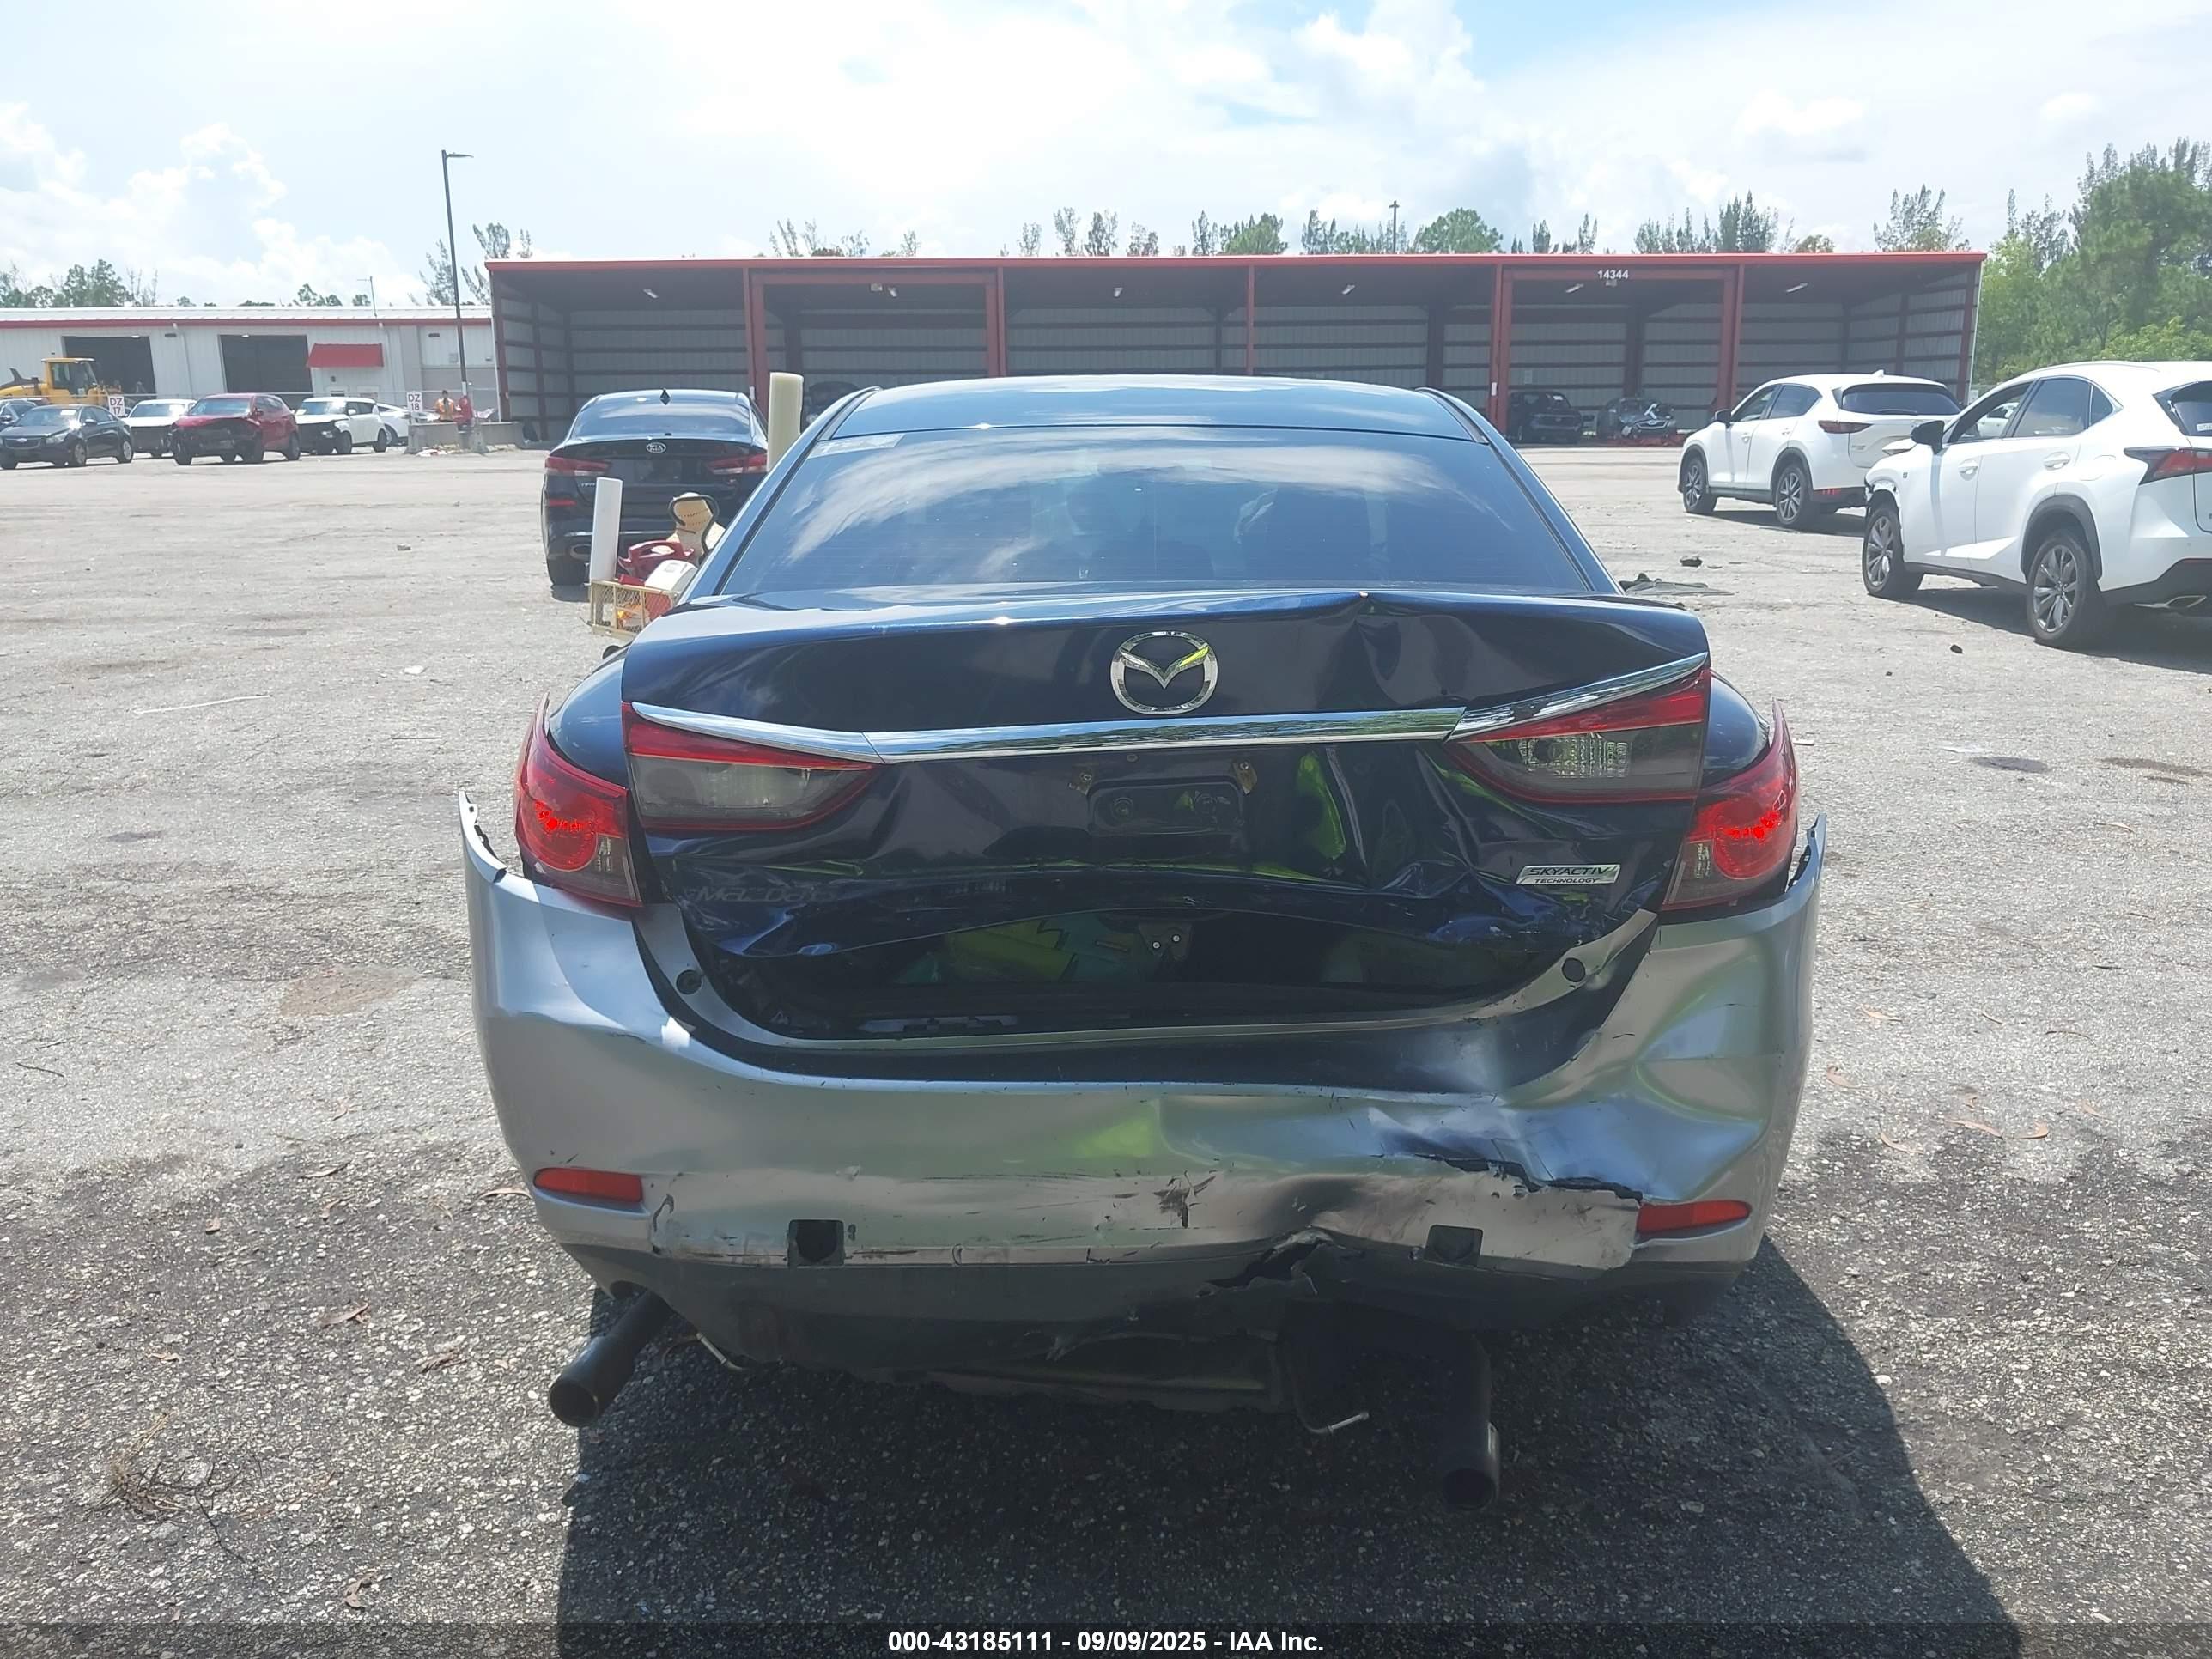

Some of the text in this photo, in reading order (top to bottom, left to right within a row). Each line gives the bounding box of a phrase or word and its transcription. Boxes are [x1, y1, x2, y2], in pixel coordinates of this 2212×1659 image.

[1597, 269, 1629, 280] 14344
[109, 397, 123, 406] DZ
[408, 393, 421, 403] DZ
[410, 403, 420, 411] 18
[1528, 866, 1609, 876] SKYACTIV
